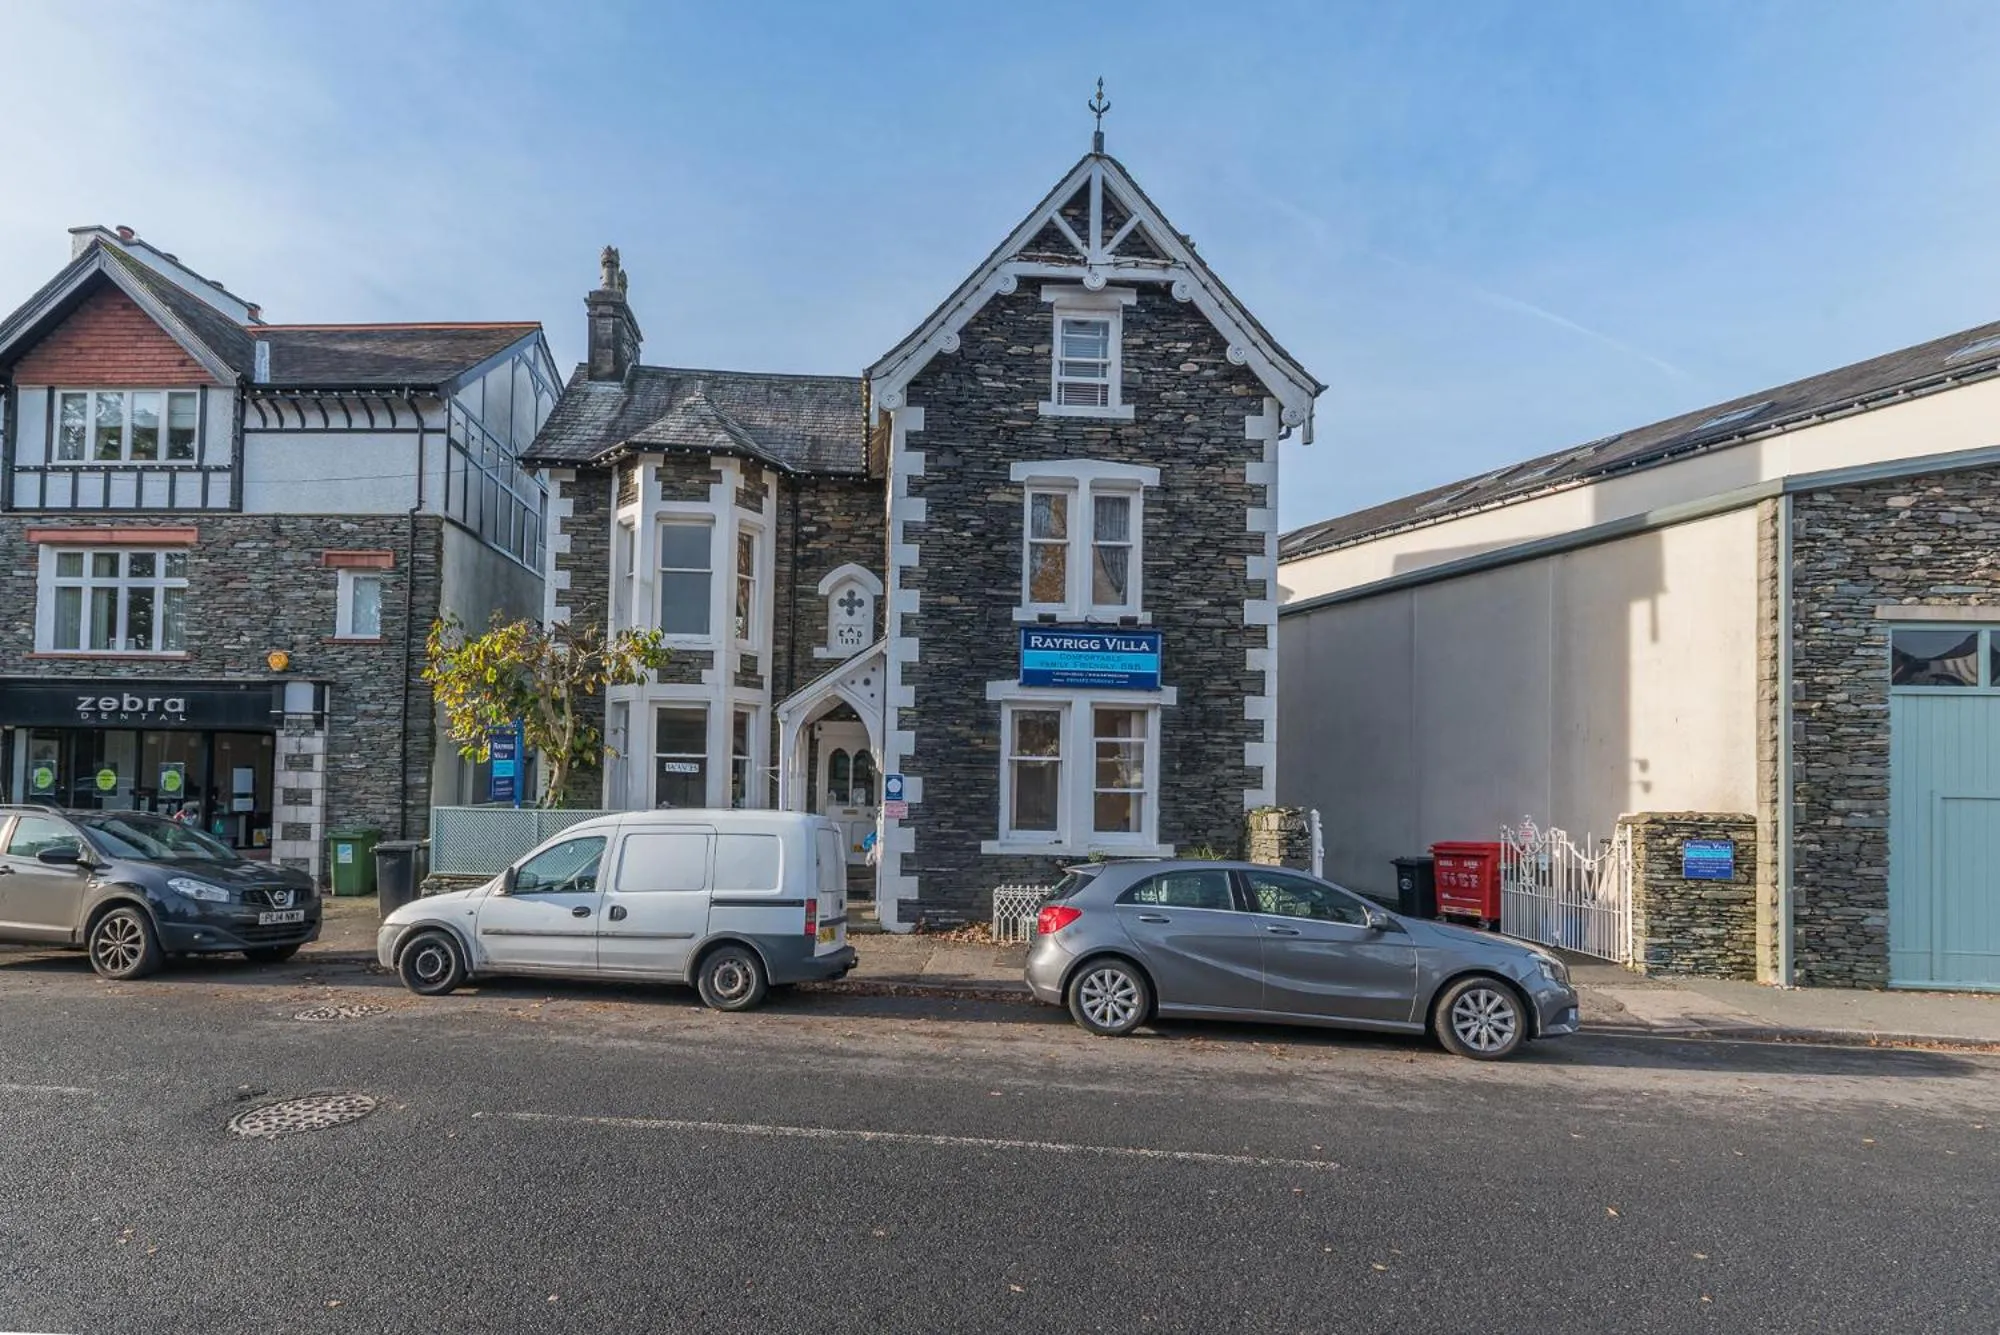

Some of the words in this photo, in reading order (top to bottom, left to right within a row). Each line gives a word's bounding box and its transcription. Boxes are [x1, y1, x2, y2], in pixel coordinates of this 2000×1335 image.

[1031, 635, 1101, 649] RAYRIGG
[1104, 638, 1150, 651] VILLA
[76, 692, 185, 712] zebra
[80, 712, 187, 721] DENTAL
